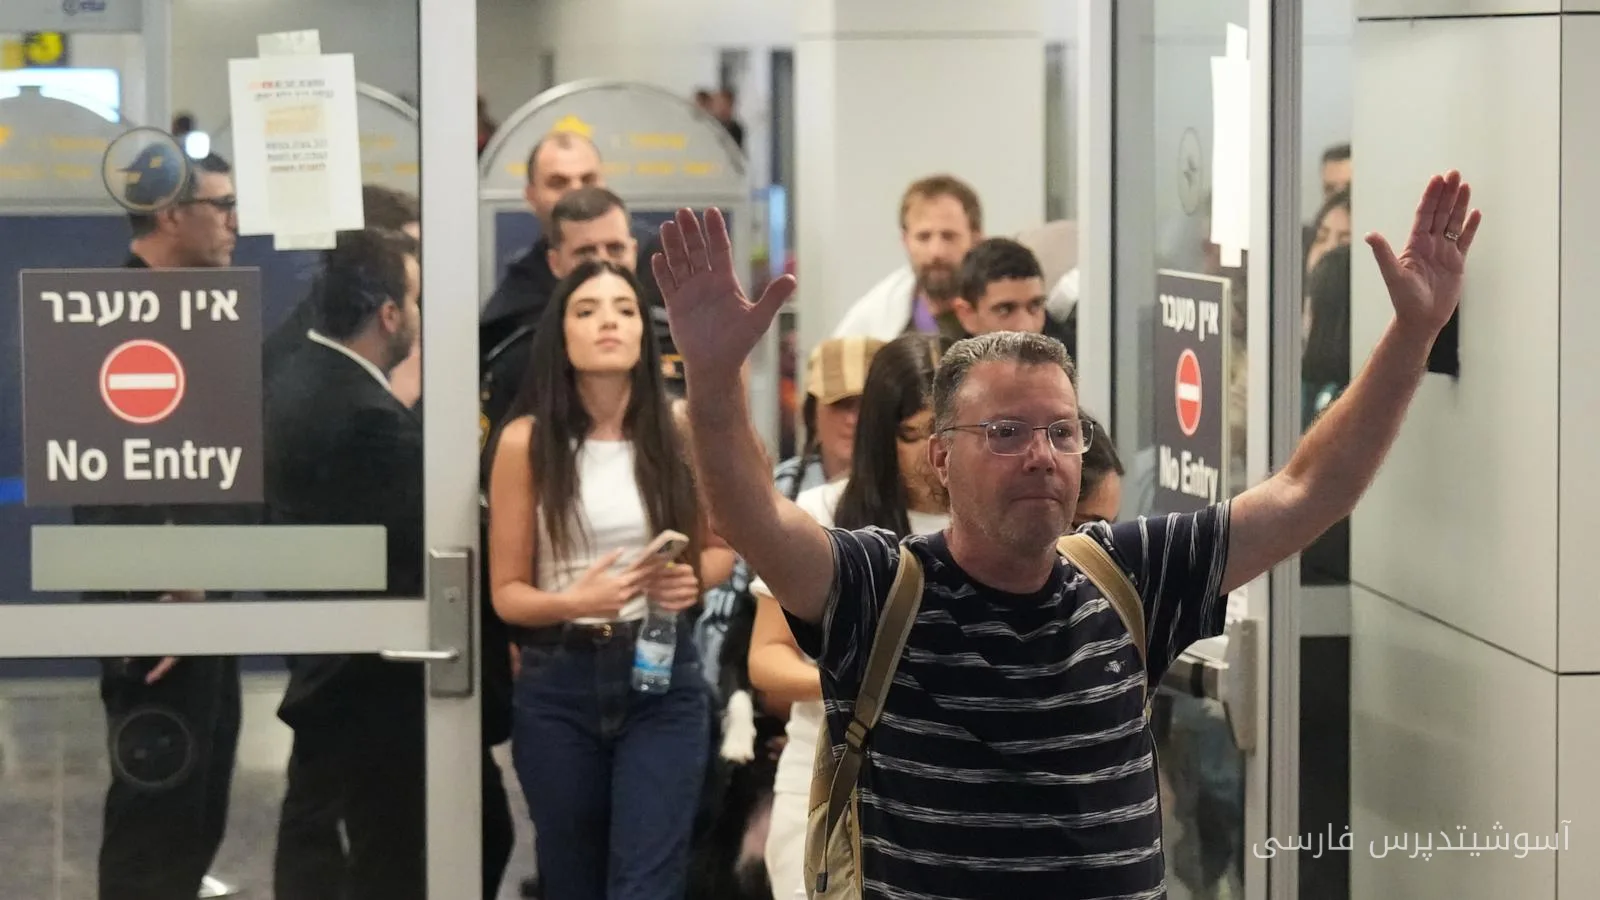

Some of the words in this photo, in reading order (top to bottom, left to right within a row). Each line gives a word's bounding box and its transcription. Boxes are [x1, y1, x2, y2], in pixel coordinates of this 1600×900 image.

[40, 289, 161, 327] מעבר
[179, 289, 240, 331] אין
[1159, 293, 1196, 333] מעבר
[1198, 300, 1220, 342] אין
[46, 438, 108, 482] No
[123, 437, 243, 491] Entry
[1159, 445, 1180, 491] No
[1180, 450, 1219, 506] Entry
